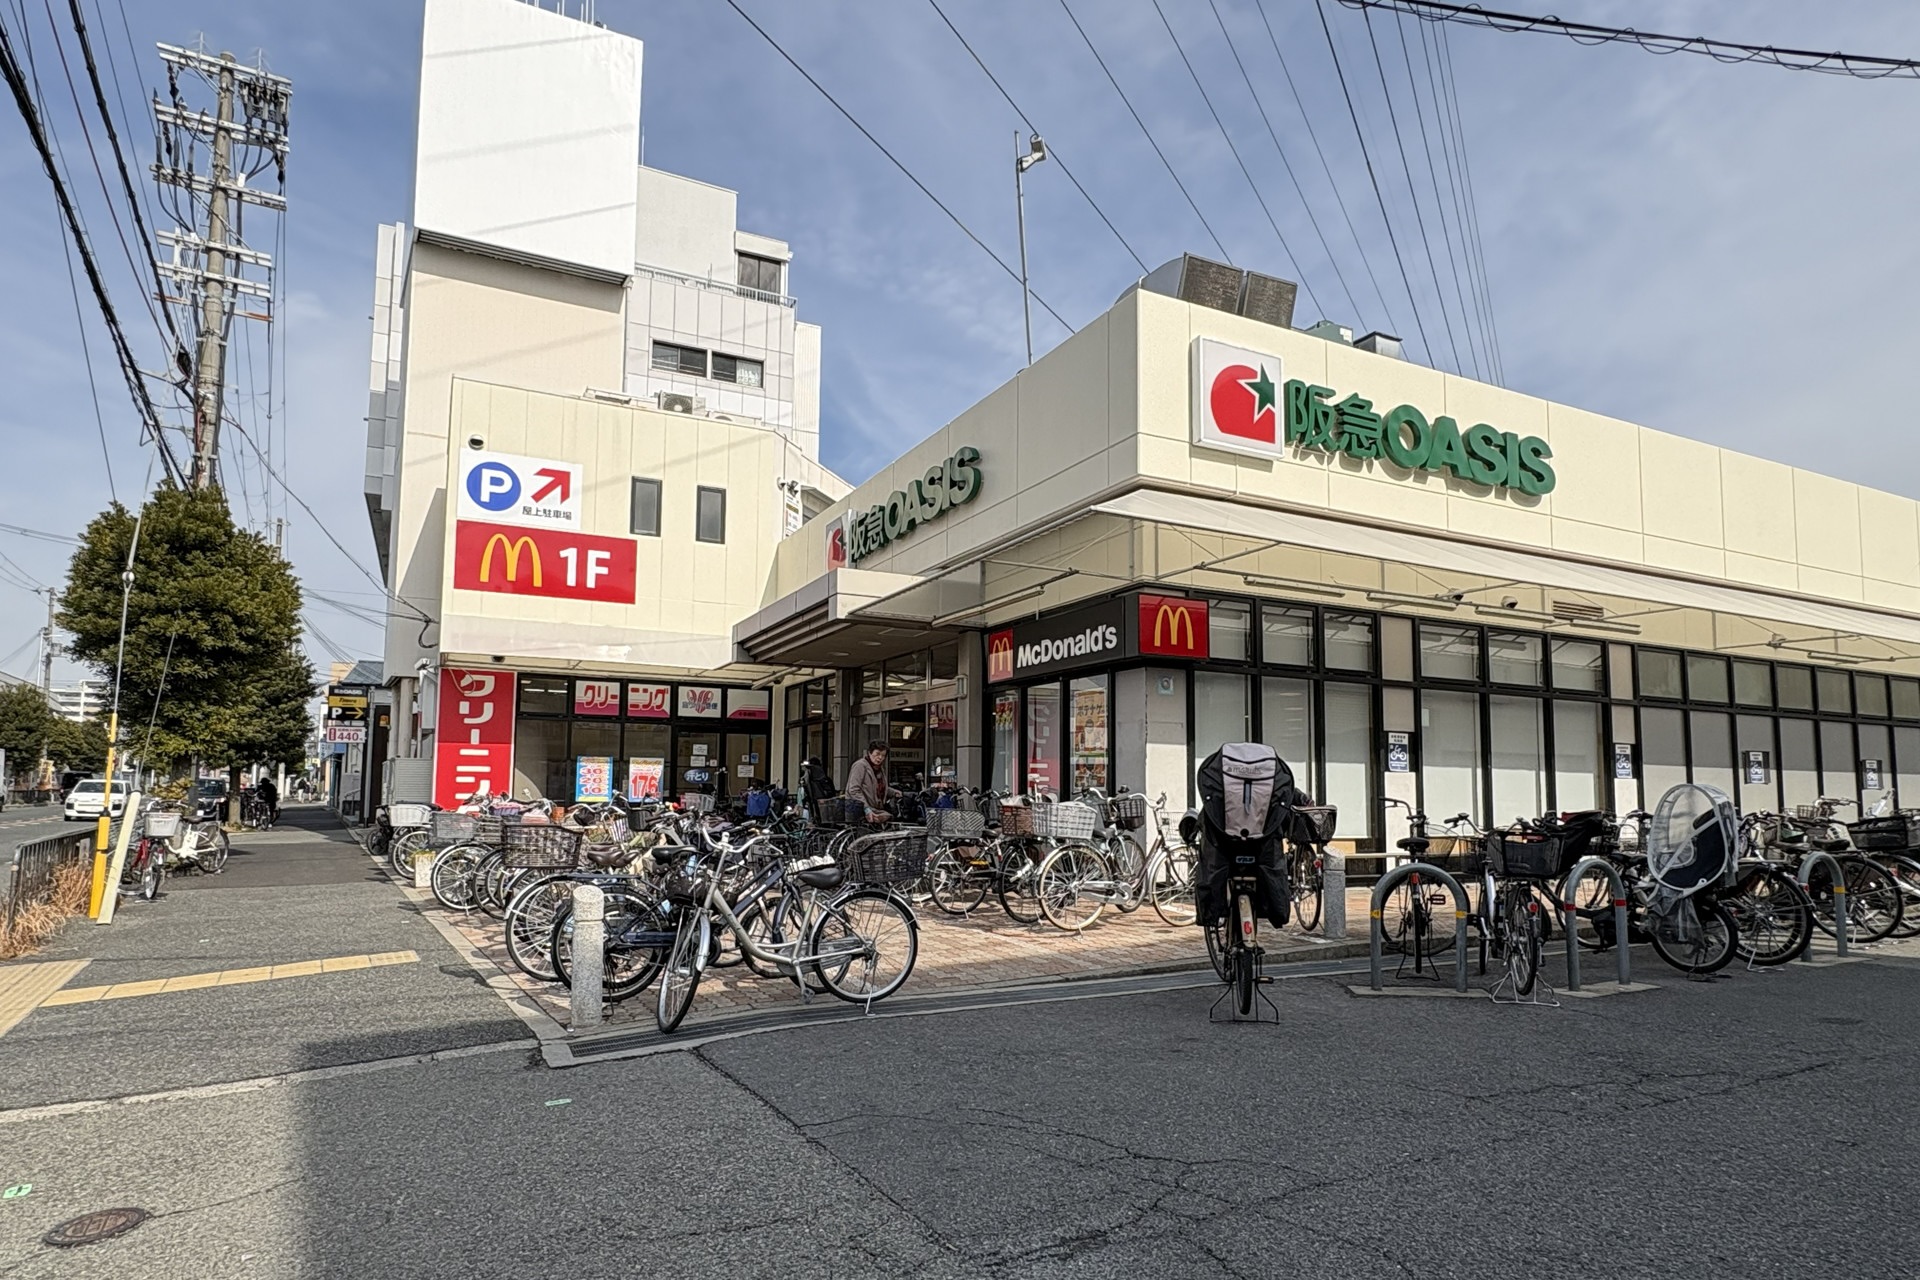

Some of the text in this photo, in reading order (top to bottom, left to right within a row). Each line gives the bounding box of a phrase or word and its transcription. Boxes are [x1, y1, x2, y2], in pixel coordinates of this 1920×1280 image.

[1284, 379, 1556, 496] 阪急OASIS
[480, 468, 513, 502] P
[522, 506, 572, 521] 屋上駐車場
[559, 547, 611, 588] 1F
[1016, 624, 1117, 668] McDonald's
[331, 707, 342, 719] P
[337, 732, 359, 741] 440
